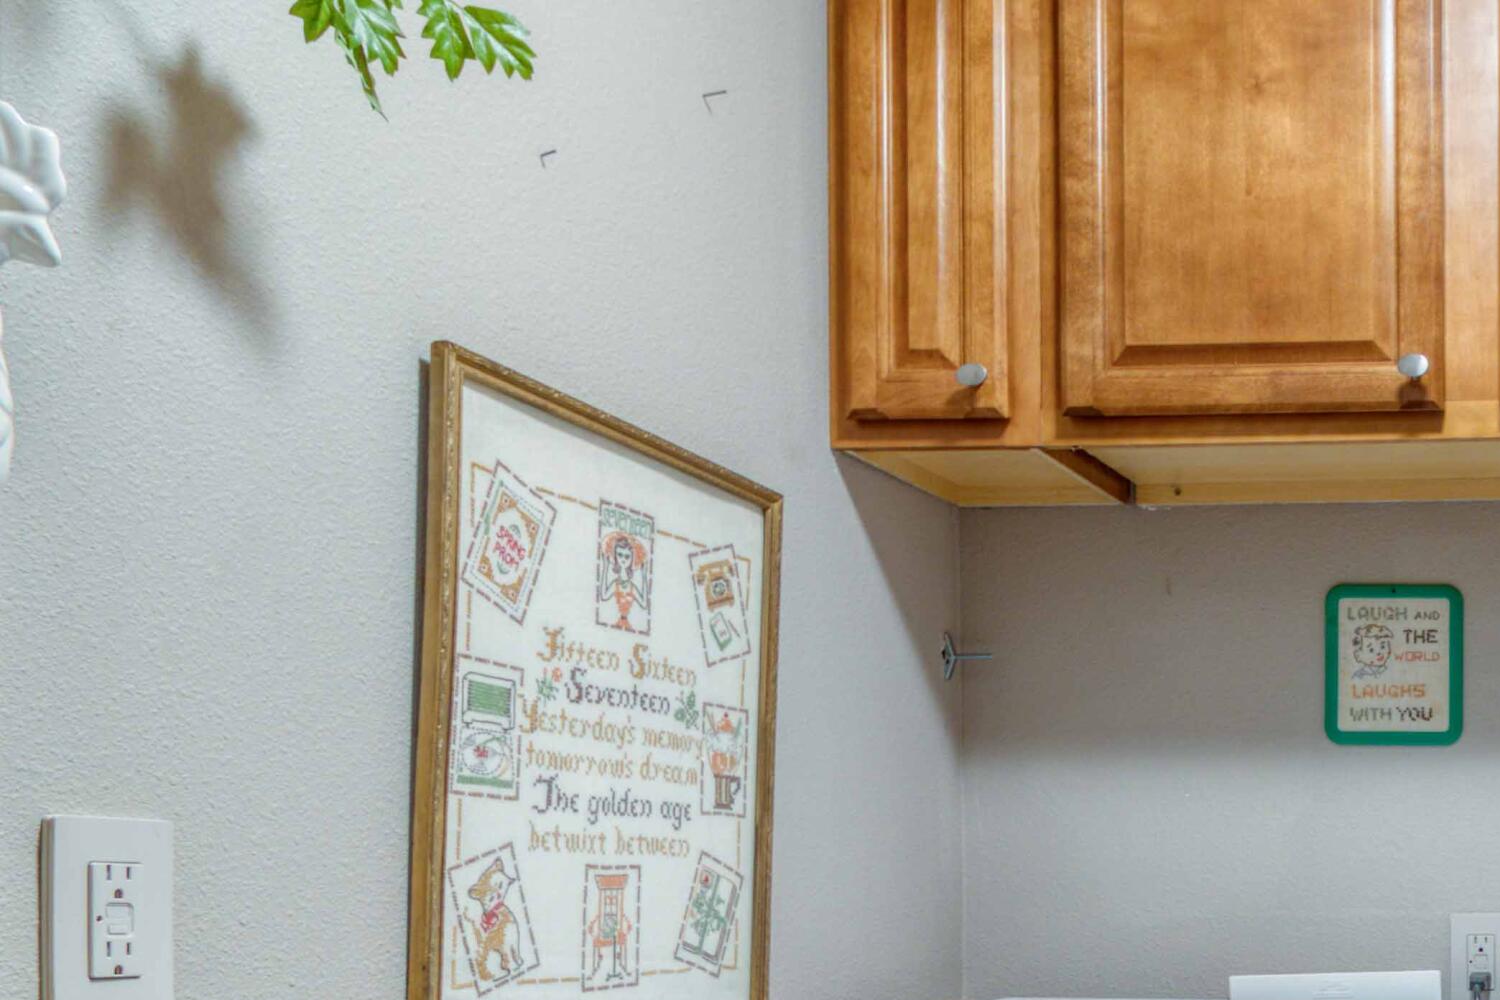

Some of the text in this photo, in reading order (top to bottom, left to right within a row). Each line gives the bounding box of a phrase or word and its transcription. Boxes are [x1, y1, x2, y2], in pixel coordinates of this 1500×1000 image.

[492, 541, 521, 566] PROM
[495, 525, 527, 560] SPRING
[1347, 606, 1441, 621] LAUGH AND
[1402, 629, 1439, 644] THE
[536, 626, 697, 688] Fifteen Sixteen
[1394, 651, 1441, 662] WORLD
[564, 667, 671, 715] Seventeen
[1351, 683, 1427, 699] LAUGHS
[517, 692, 706, 760] Yesterday's memory
[1350, 706, 1434, 722] WITH YOU
[525, 740, 698, 785] tomorrow's dream
[532, 773, 692, 831] The golden age
[527, 819, 691, 858] betwixt between
